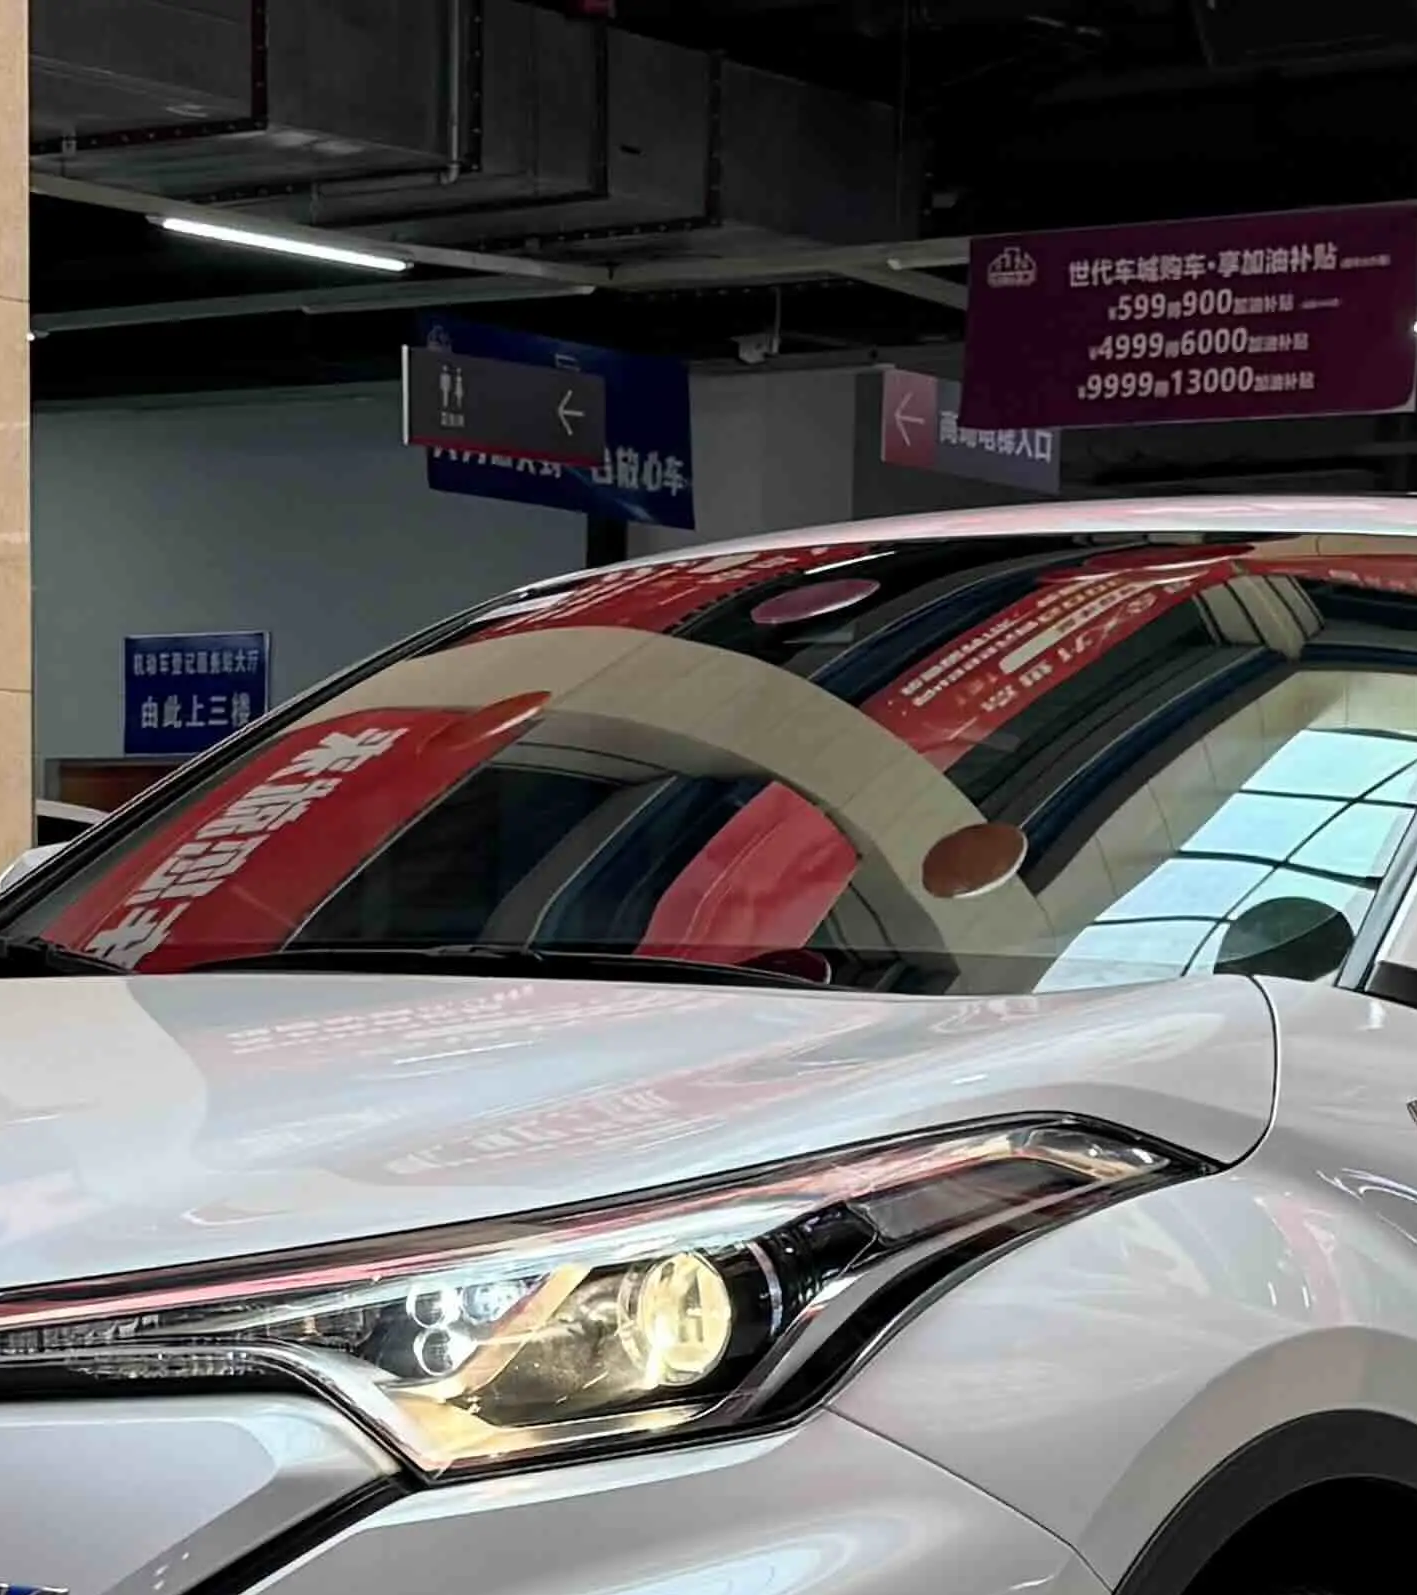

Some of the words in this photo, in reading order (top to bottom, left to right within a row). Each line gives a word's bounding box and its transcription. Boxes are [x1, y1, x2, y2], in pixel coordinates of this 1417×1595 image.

[140, 691, 252, 729] 由此上三楼
